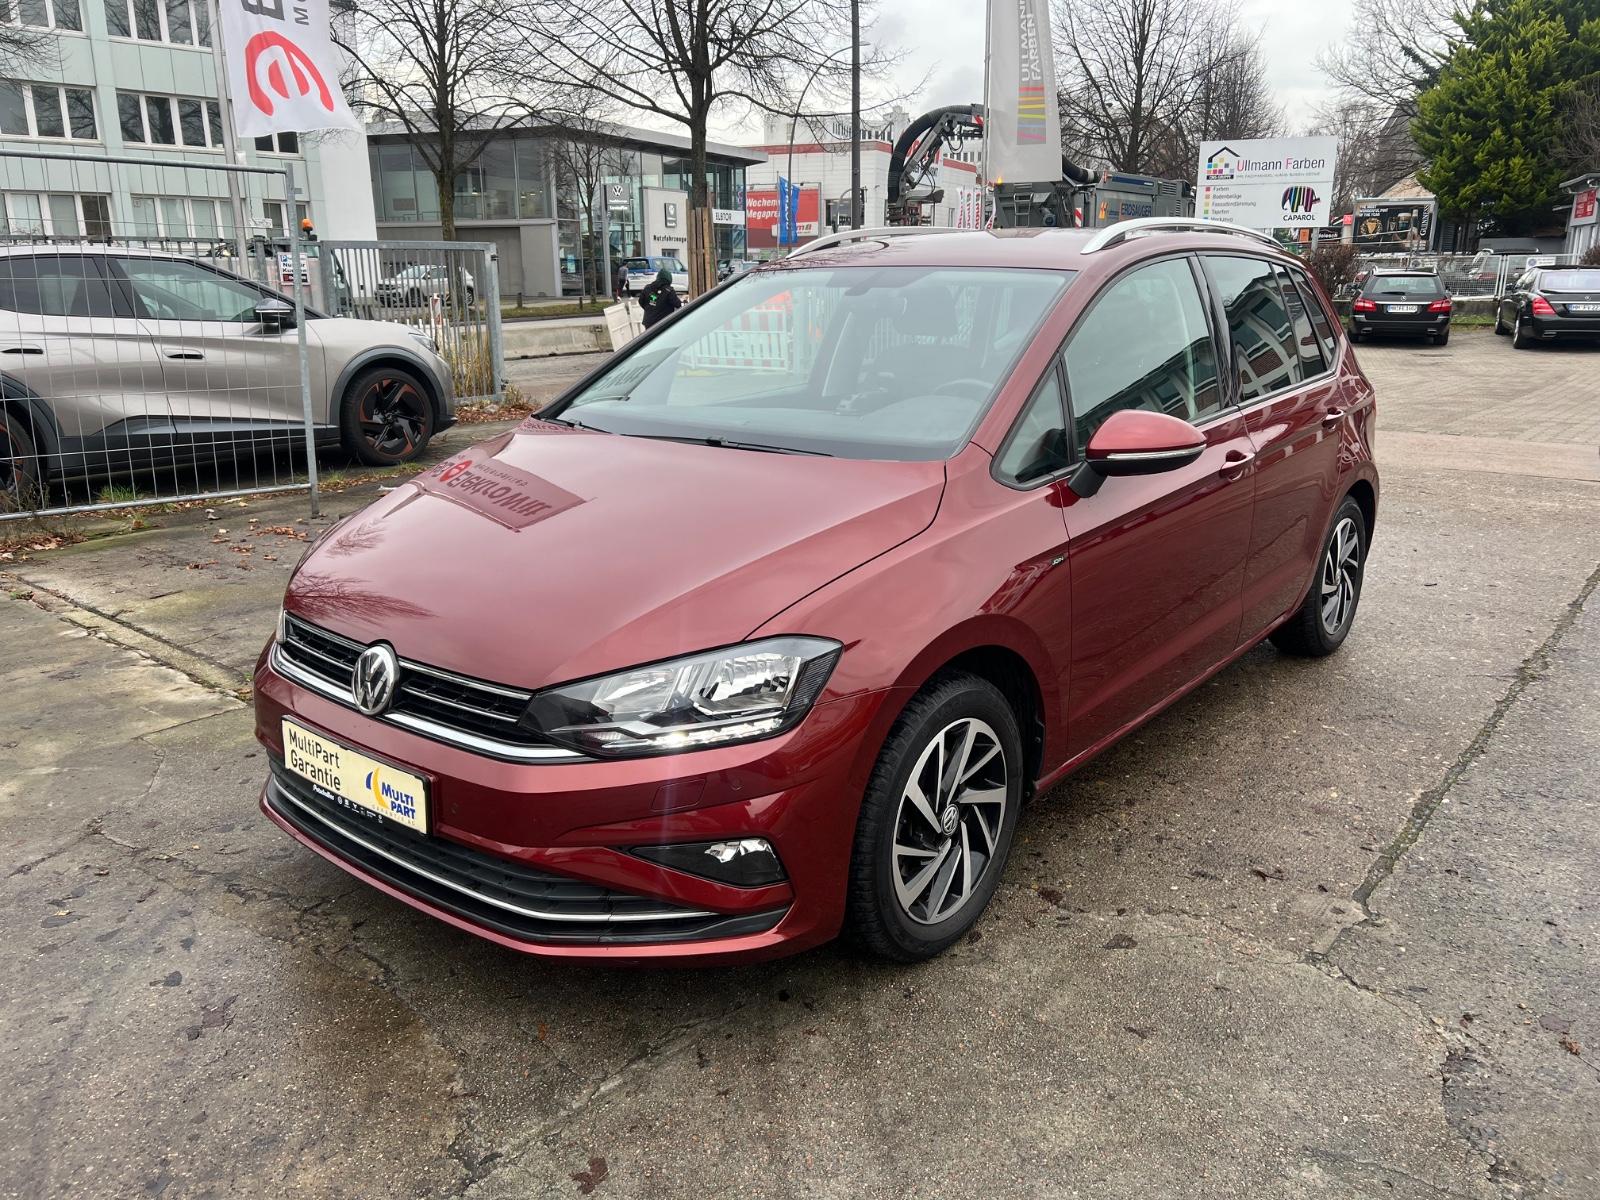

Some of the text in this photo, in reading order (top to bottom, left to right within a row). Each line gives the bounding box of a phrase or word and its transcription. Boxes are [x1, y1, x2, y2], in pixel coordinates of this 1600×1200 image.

[1027, 14, 1041, 80] FARBEN
[1236, 157, 1325, 172] Ullmann Farben
[1283, 214, 1316, 222] CAPAROL
[288, 727, 340, 769] MultiPart
[290, 750, 341, 791] Garantie
[391, 802, 416, 819] PART
